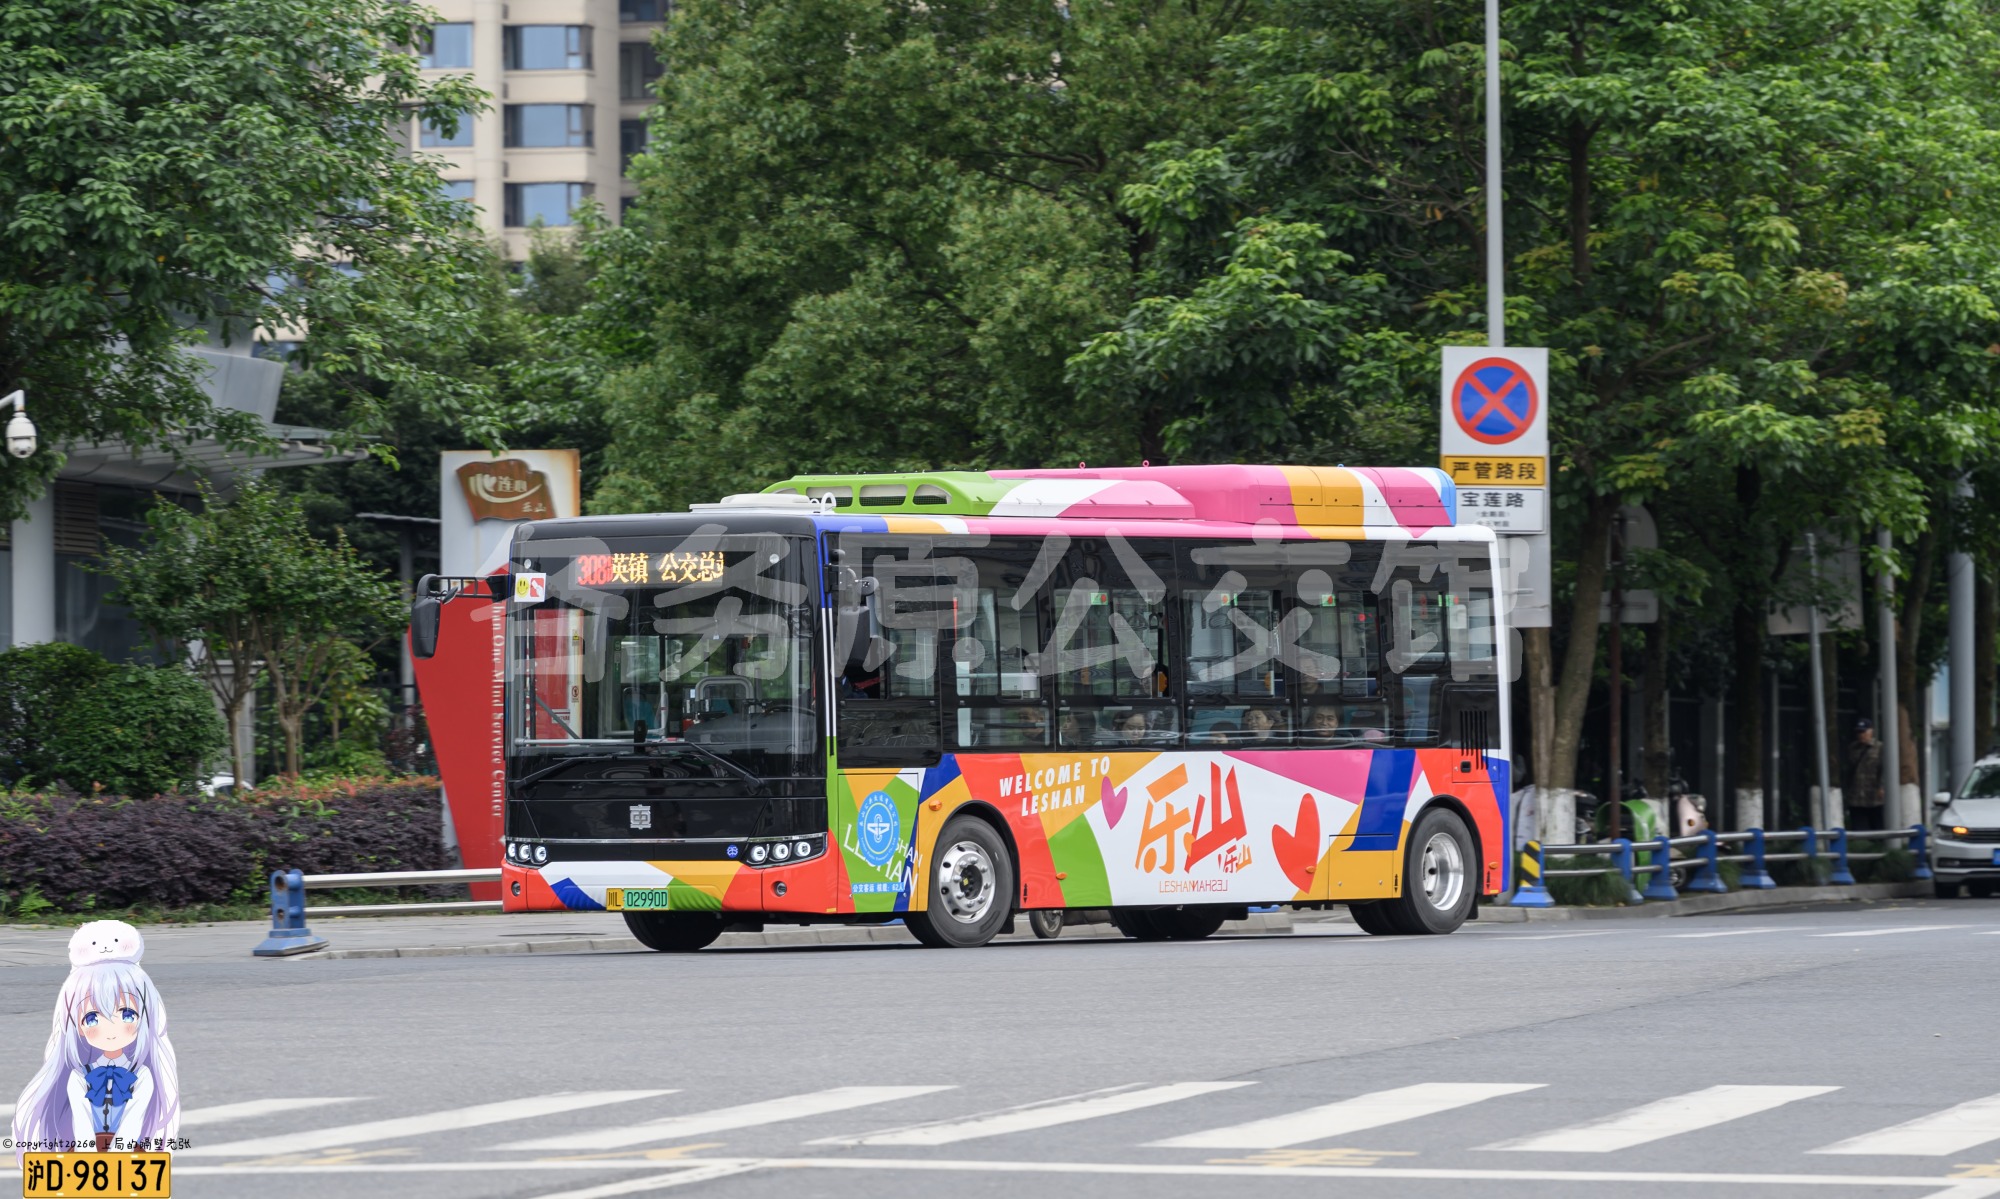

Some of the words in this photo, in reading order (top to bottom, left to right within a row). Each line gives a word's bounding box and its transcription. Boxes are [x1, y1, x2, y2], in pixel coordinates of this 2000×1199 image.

[1451, 461, 1537, 480] 严管路段
[1461, 491, 1525, 508] 宝莲路
[492, 635, 504, 663] One
[492, 670, 504, 707] Mind
[492, 712, 504, 764] Service
[492, 769, 505, 818] Center
[1000, 762, 1081, 797] WELCOME
[1091, 756, 1110, 777] TO
[1021, 785, 1085, 817] LESHAN
[1135, 761, 1247, 874] 乐山
